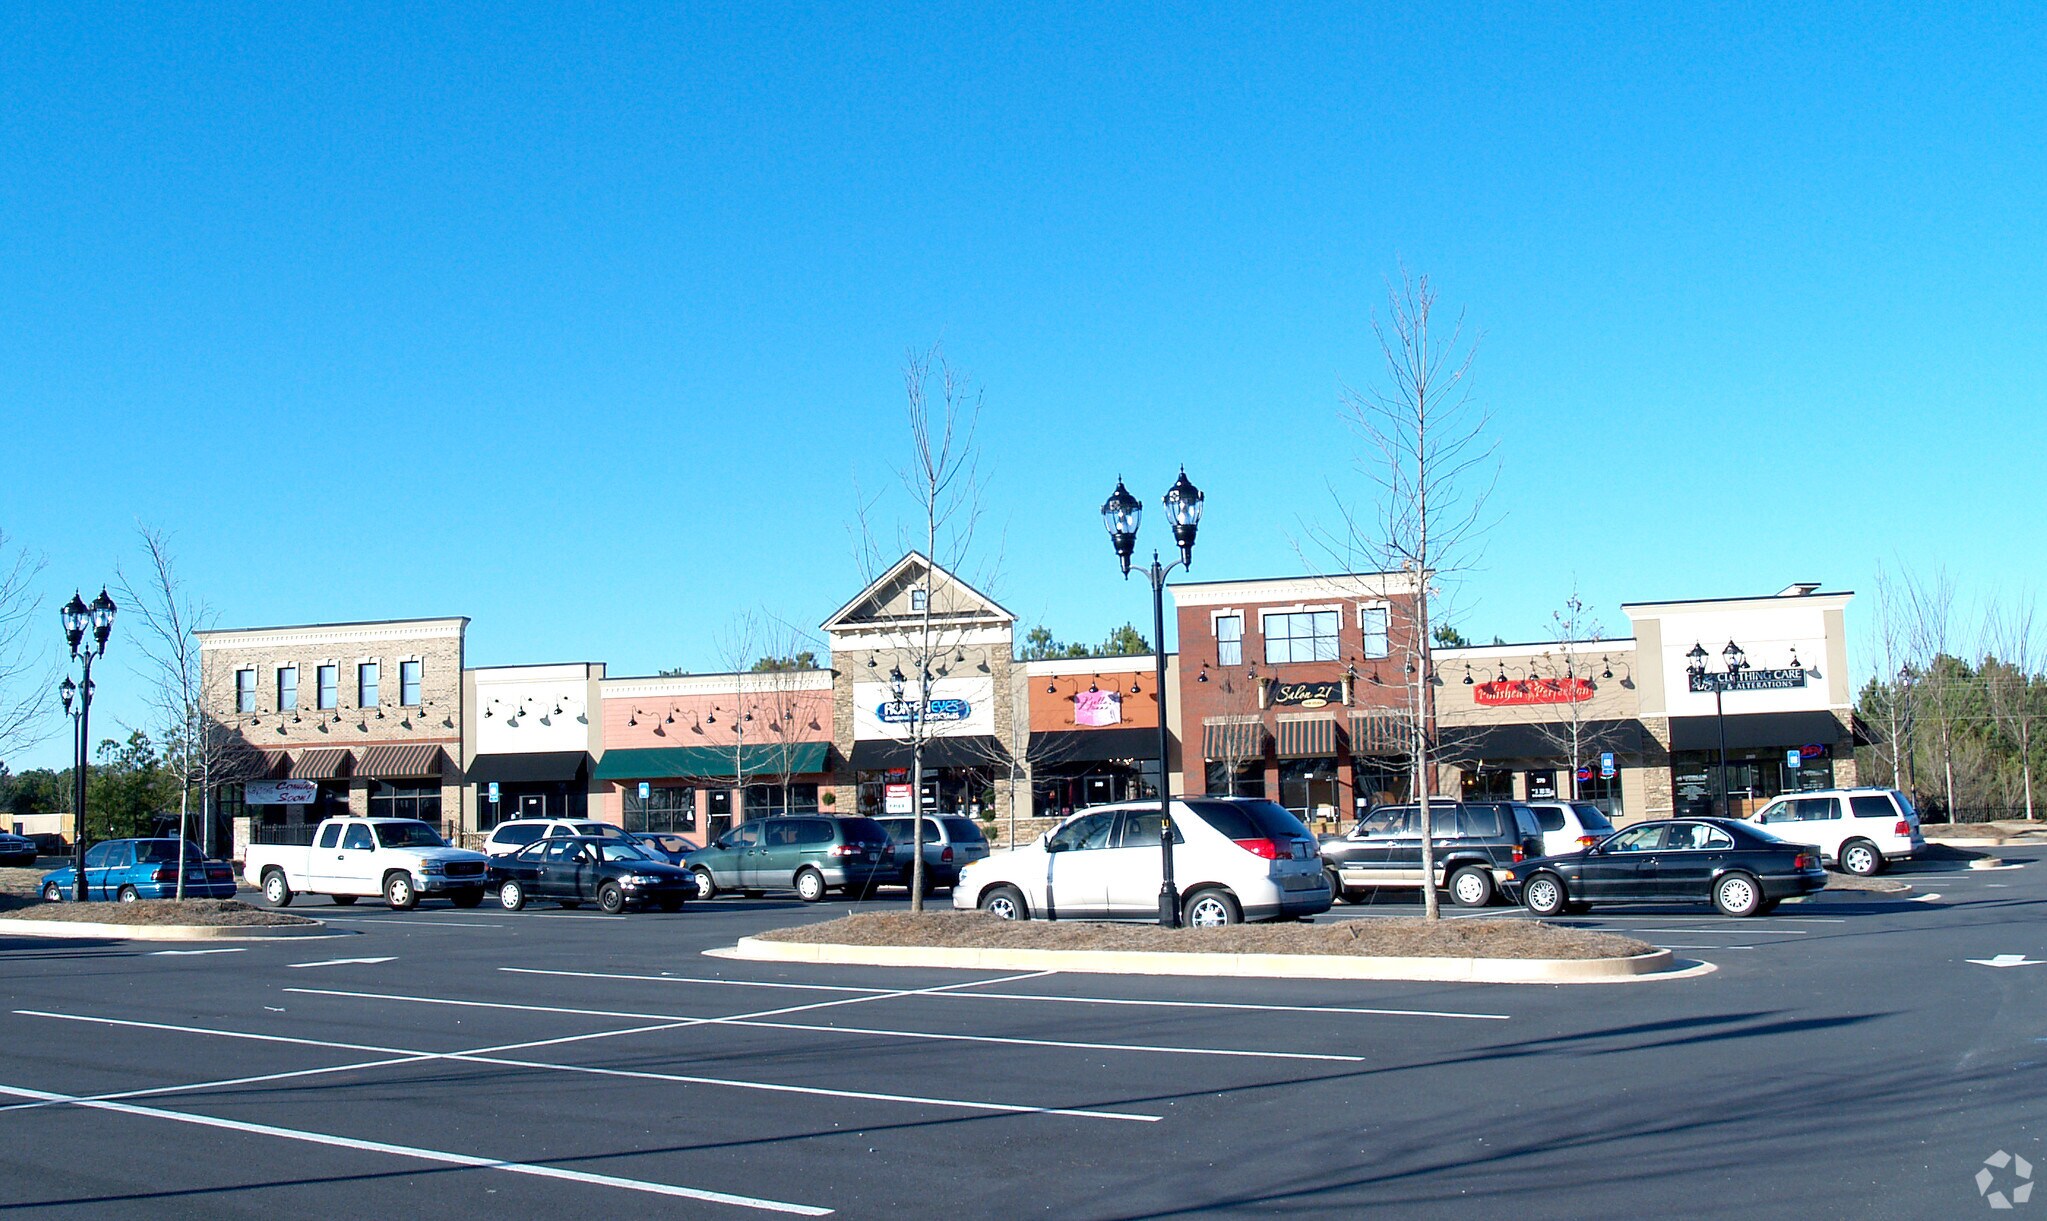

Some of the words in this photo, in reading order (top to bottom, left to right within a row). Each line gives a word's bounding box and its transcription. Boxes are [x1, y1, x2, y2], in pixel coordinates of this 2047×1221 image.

[1773, 669, 1802, 680] CARE
[1727, 683, 1733, 691] &
[1737, 681, 1794, 690] ALTERATIONS
[1276, 685, 1313, 702] Salon
[1314, 686, 1333, 698] 21
[931, 700, 959, 713] EYES
[276, 793, 312, 802] Soon!
